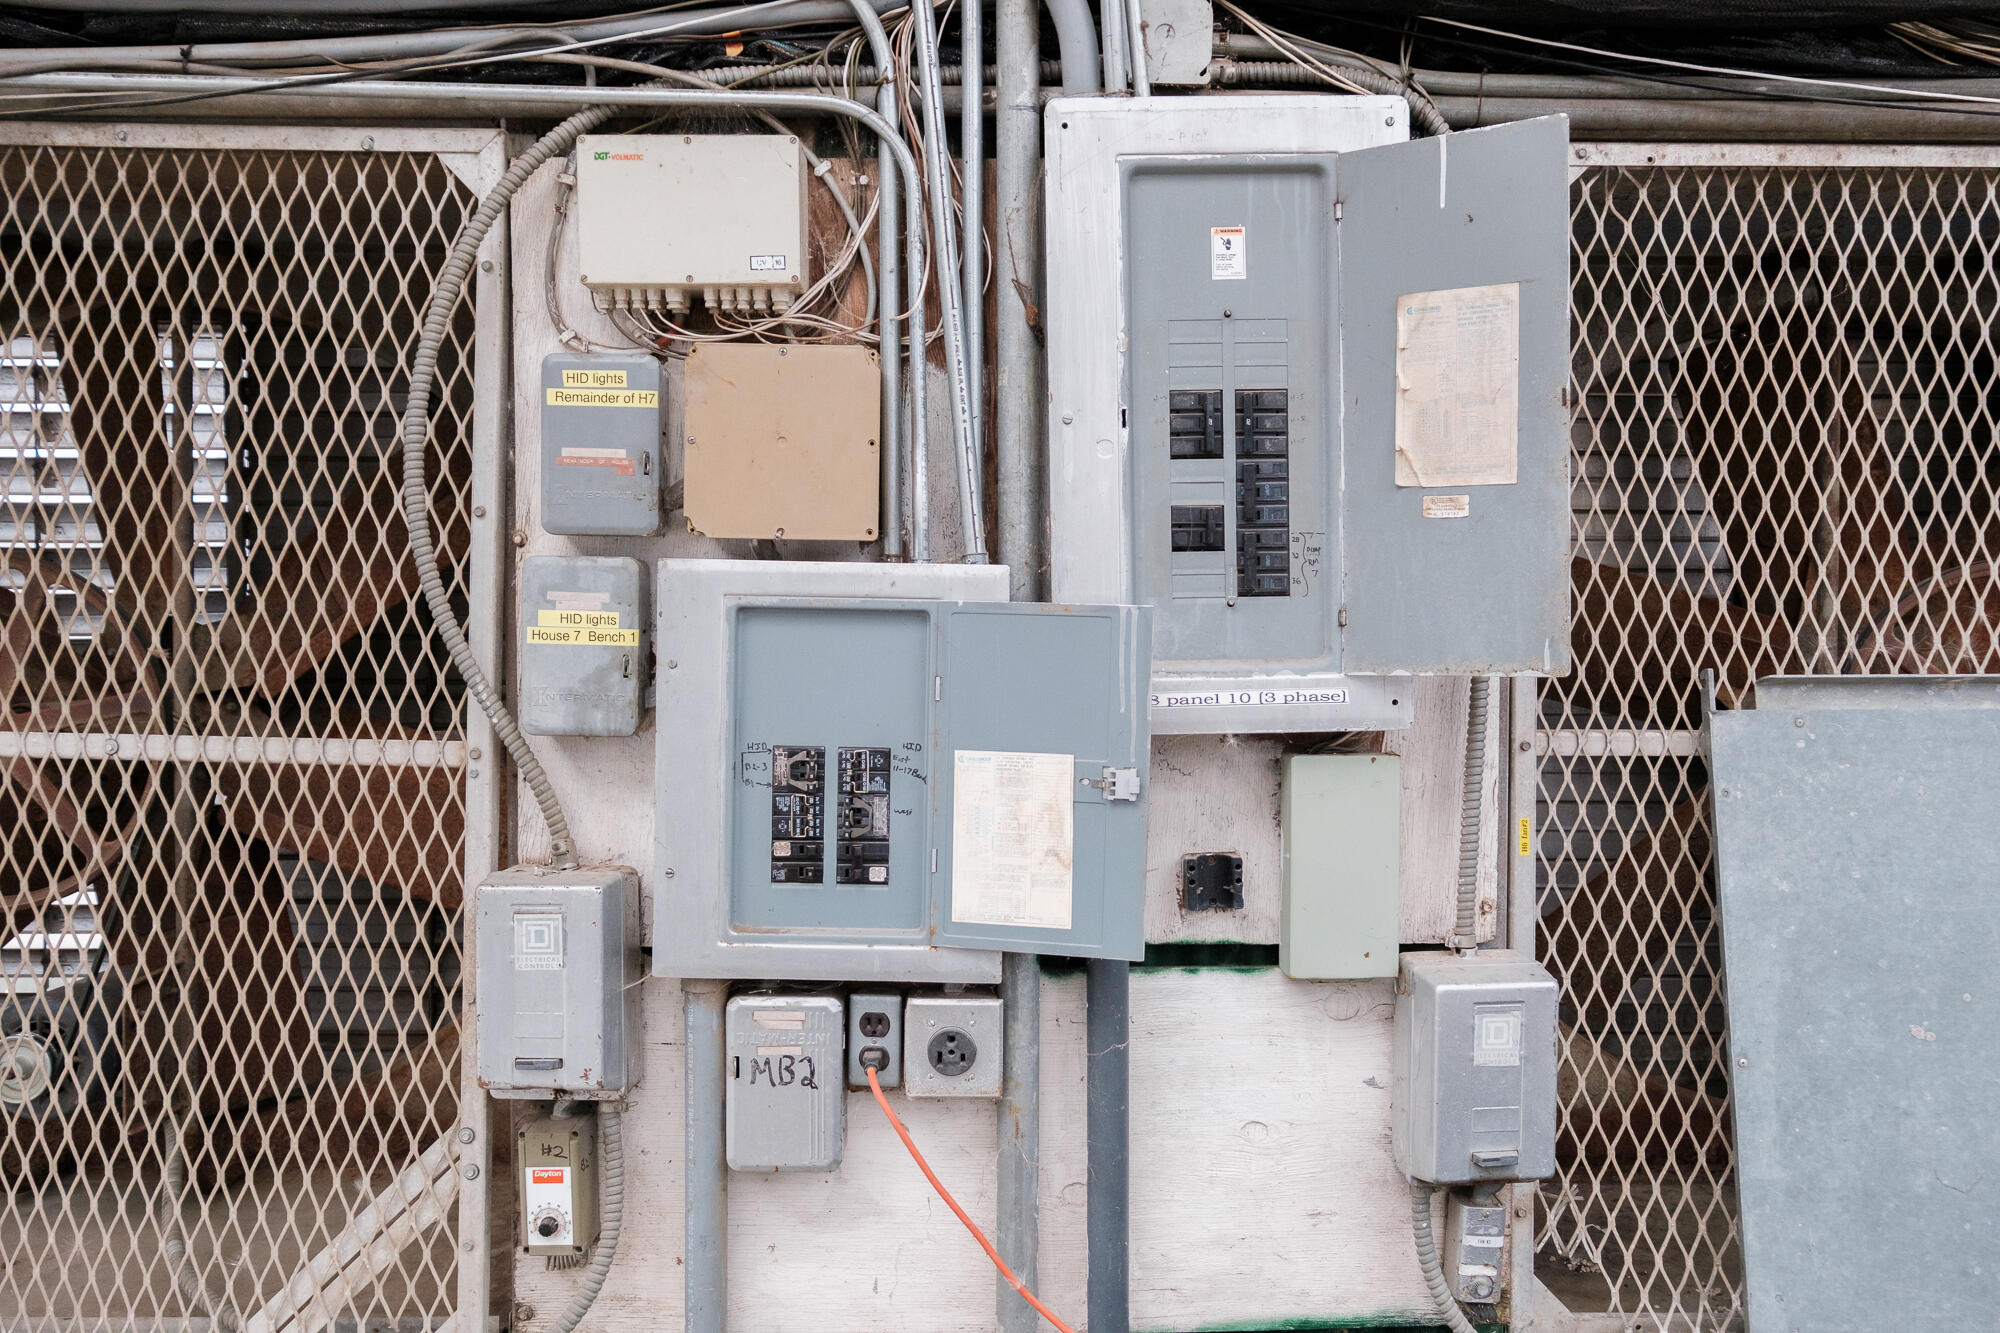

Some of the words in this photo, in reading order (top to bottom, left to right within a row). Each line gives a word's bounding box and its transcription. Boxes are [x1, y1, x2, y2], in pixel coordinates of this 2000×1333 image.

[566, 373, 589, 384] HID
[592, 373, 624, 386] lights
[555, 391, 619, 404] Remainder
[623, 392, 635, 404] of
[638, 393, 656, 404] H7
[560, 613, 582, 625] HID
[586, 614, 617, 627] lights
[532, 630, 570, 641] House
[574, 631, 581, 641] 7
[588, 631, 626, 643] Bench
[630, 632, 636, 642] 1
[1167, 693, 1220, 707] panel
[1229, 692, 1251, 704] 10
[902, 742, 922, 752] HID
[750, 1055, 818, 1090] MB2
[534, 1170, 562, 1179] Dayton
